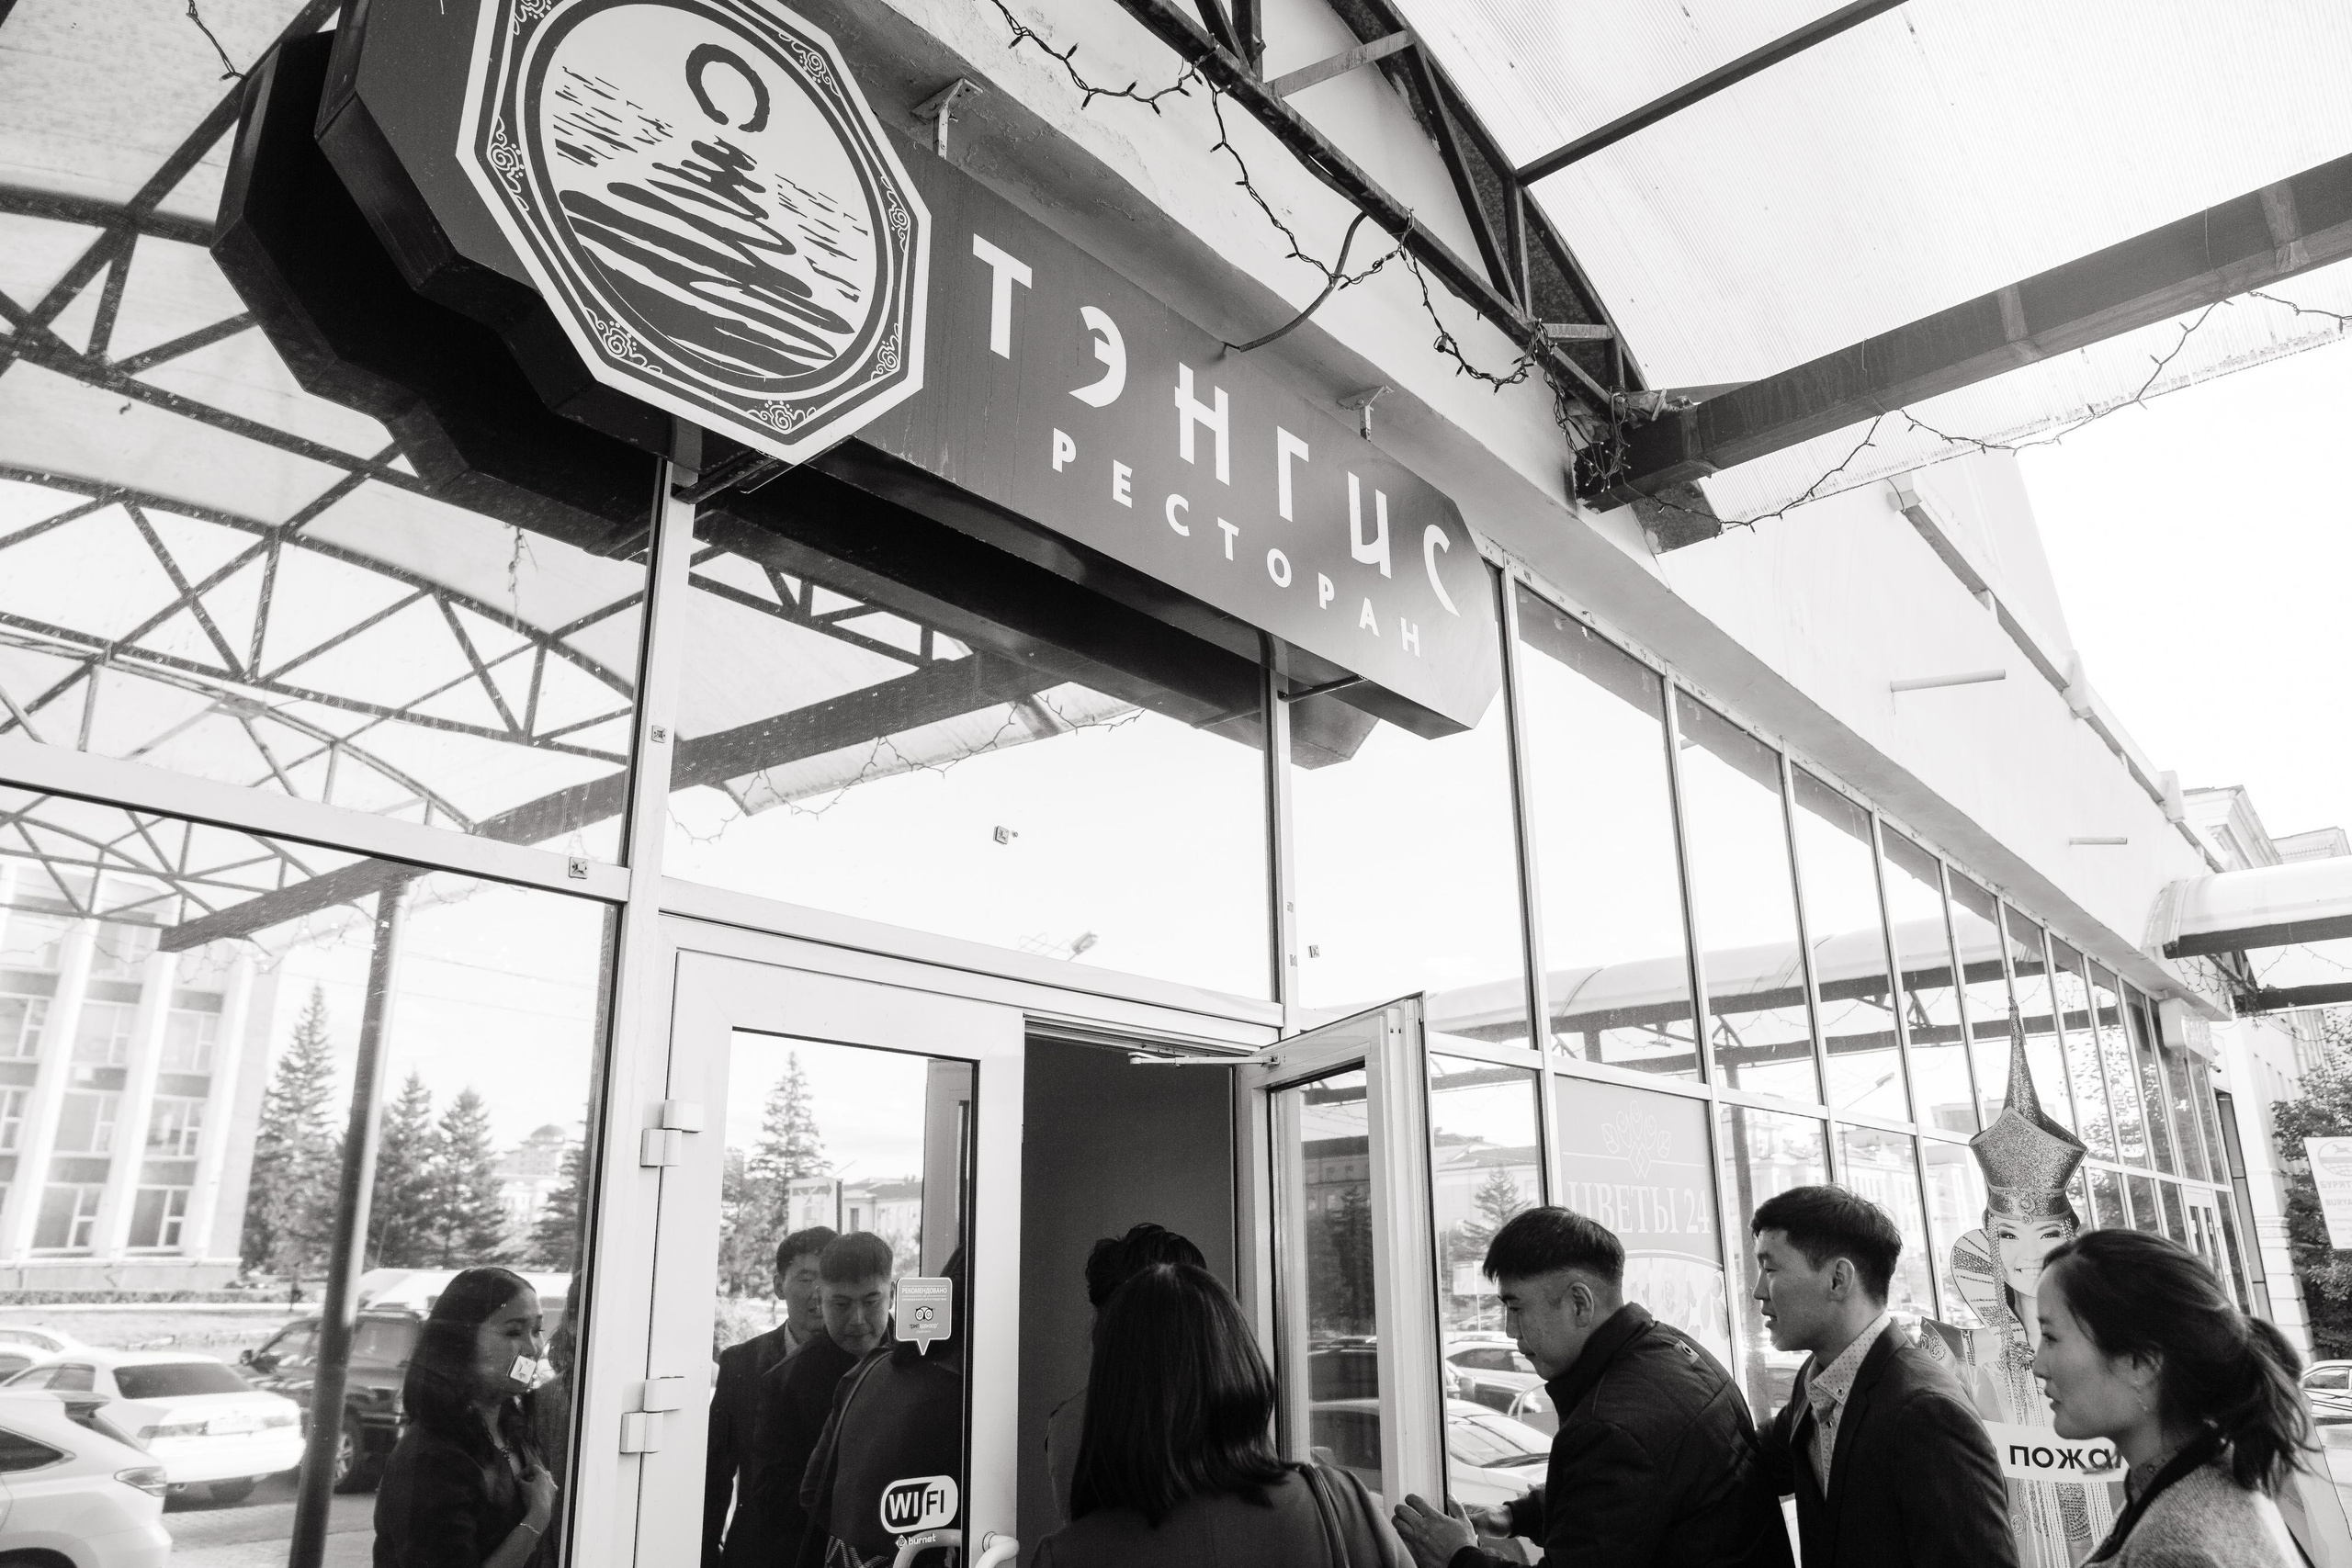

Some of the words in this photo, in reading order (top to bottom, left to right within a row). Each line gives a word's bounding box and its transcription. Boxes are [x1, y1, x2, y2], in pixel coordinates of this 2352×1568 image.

[972, 232, 1462, 618] ТЭНГИС
[1052, 427, 1421, 658] РЕСТОРАН
[1683, 1187, 1711, 1235] 24
[901, 1287, 948, 1295] РЕКОМЕНДОВАНО
[908, 1533, 936, 1546] burnet
